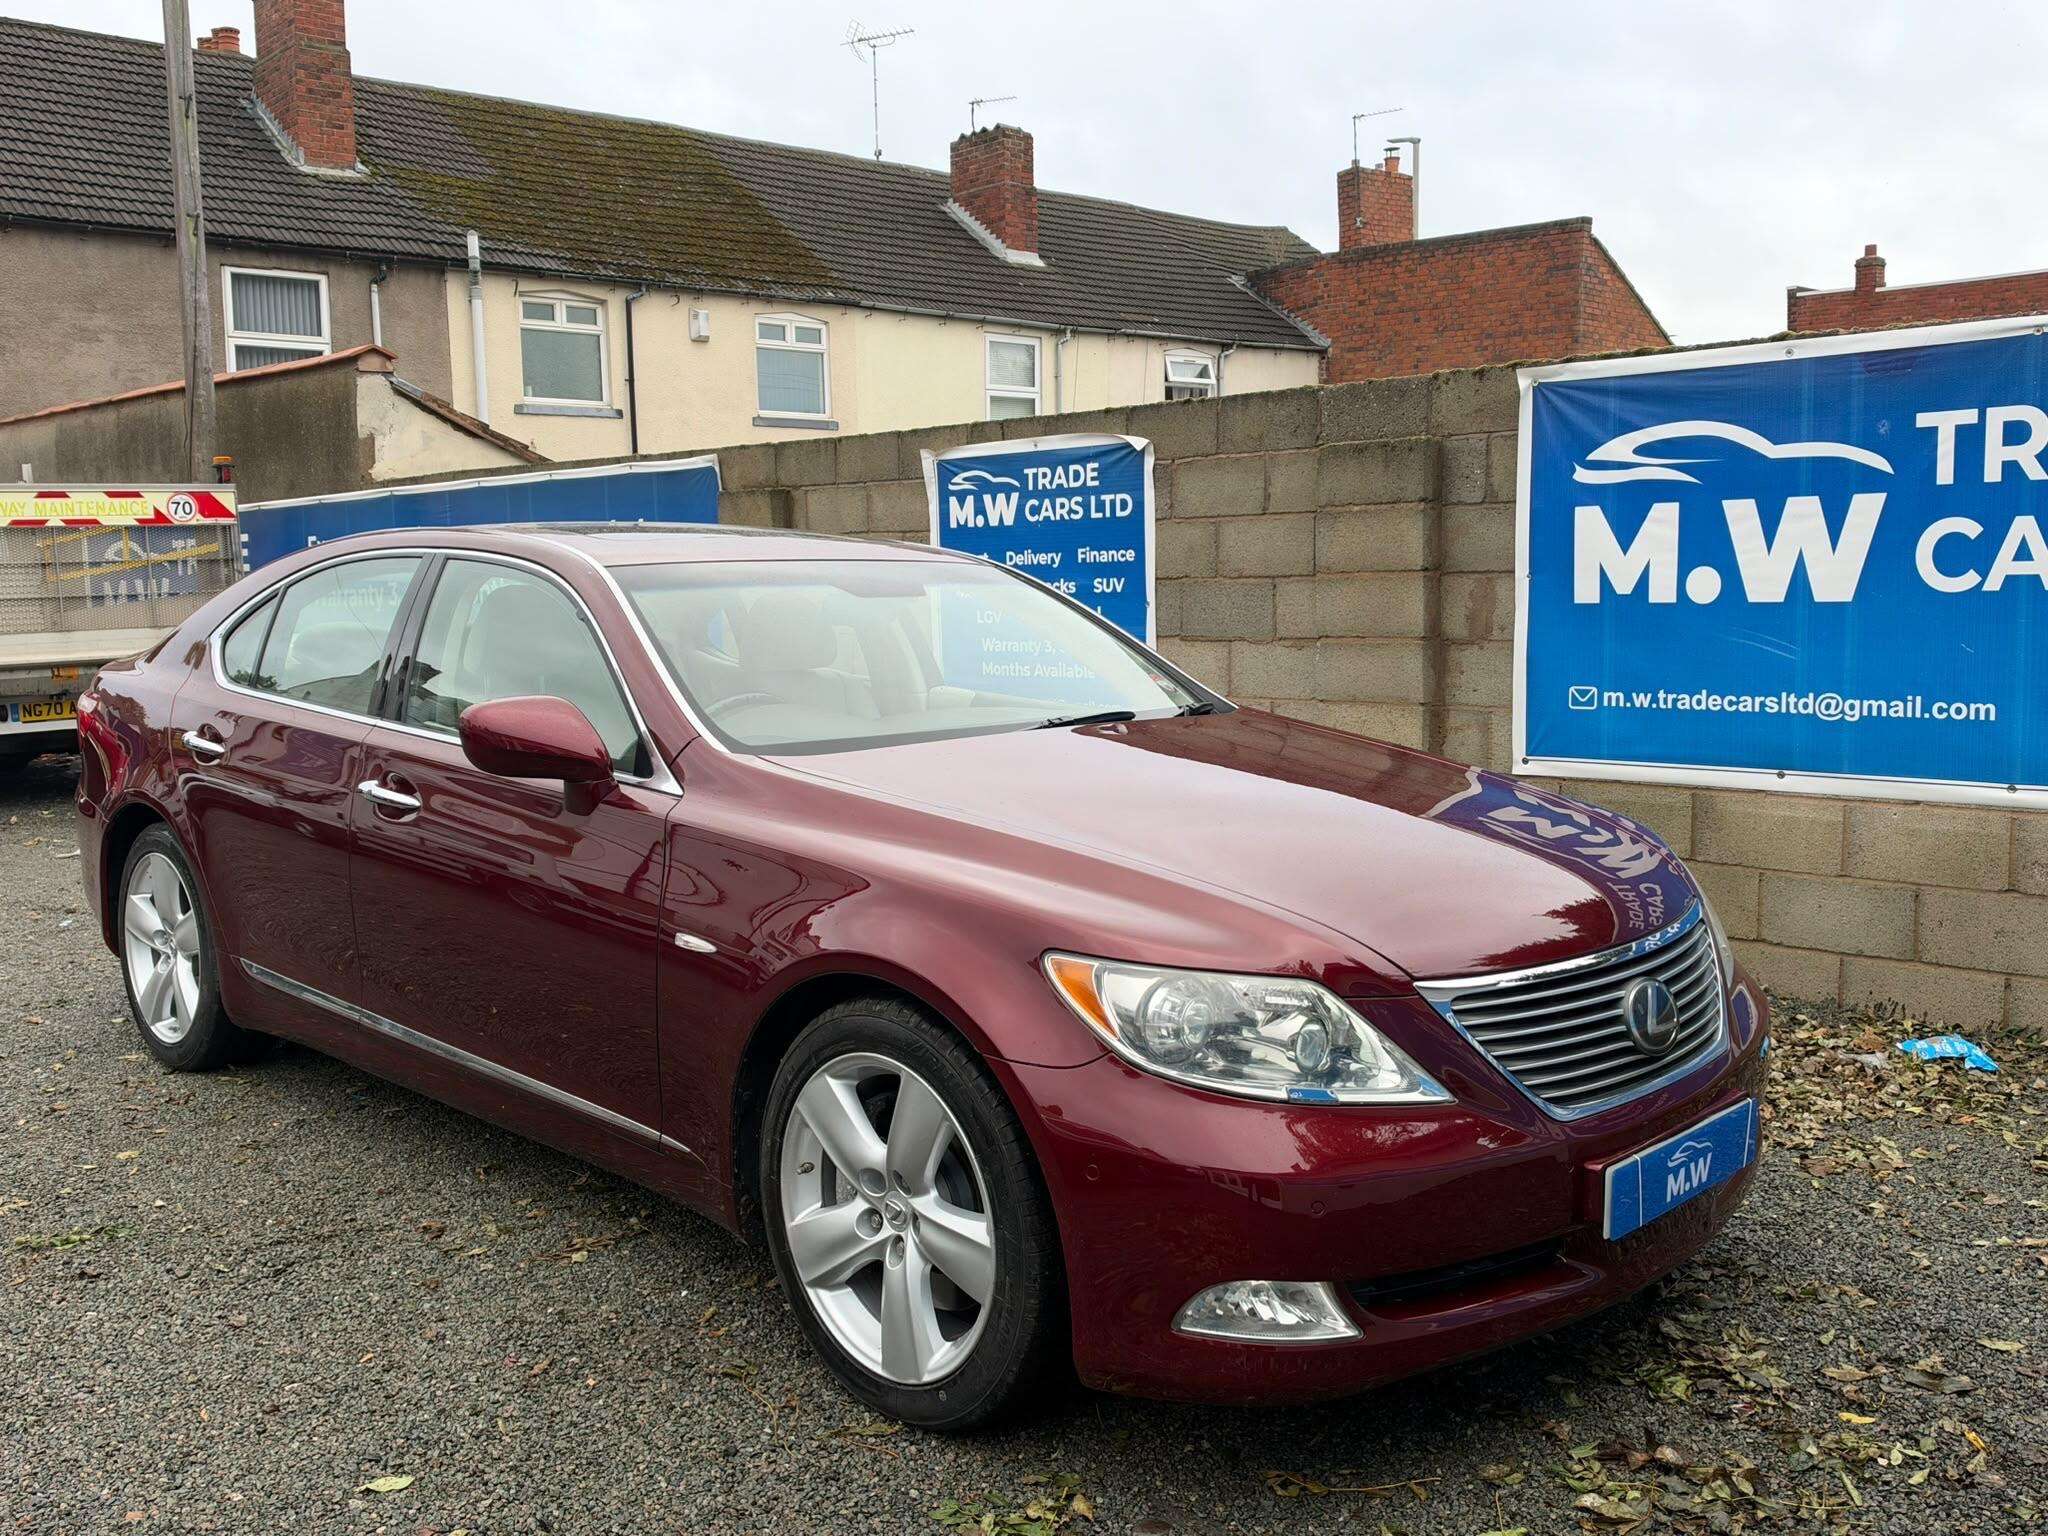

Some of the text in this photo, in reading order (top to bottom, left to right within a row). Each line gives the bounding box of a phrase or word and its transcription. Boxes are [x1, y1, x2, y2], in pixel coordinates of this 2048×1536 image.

[1916, 404, 2048, 485] TR
[1023, 462, 1100, 491] TRADE
[34, 500, 149, 517] MAINTENANCE
[171, 501, 193, 515] 70
[949, 492, 1019, 529] M.W
[1024, 493, 1133, 522] CARS LTD
[1005, 549, 1062, 568] Delivery
[1077, 547, 1136, 564] Finance
[1573, 492, 1888, 604] M.W
[1915, 515, 2048, 593] CA
[1046, 577, 1125, 593] cks SUV
[976, 609, 1002, 624] LGV
[981, 637, 1041, 656] Warranty
[982, 661, 1096, 680] Months Available
[22, 701, 64, 718] NG70
[1602, 688, 1997, 723] m.w.tradecarsltd@gmail.com
[1666, 1151, 1713, 1204] M.W
